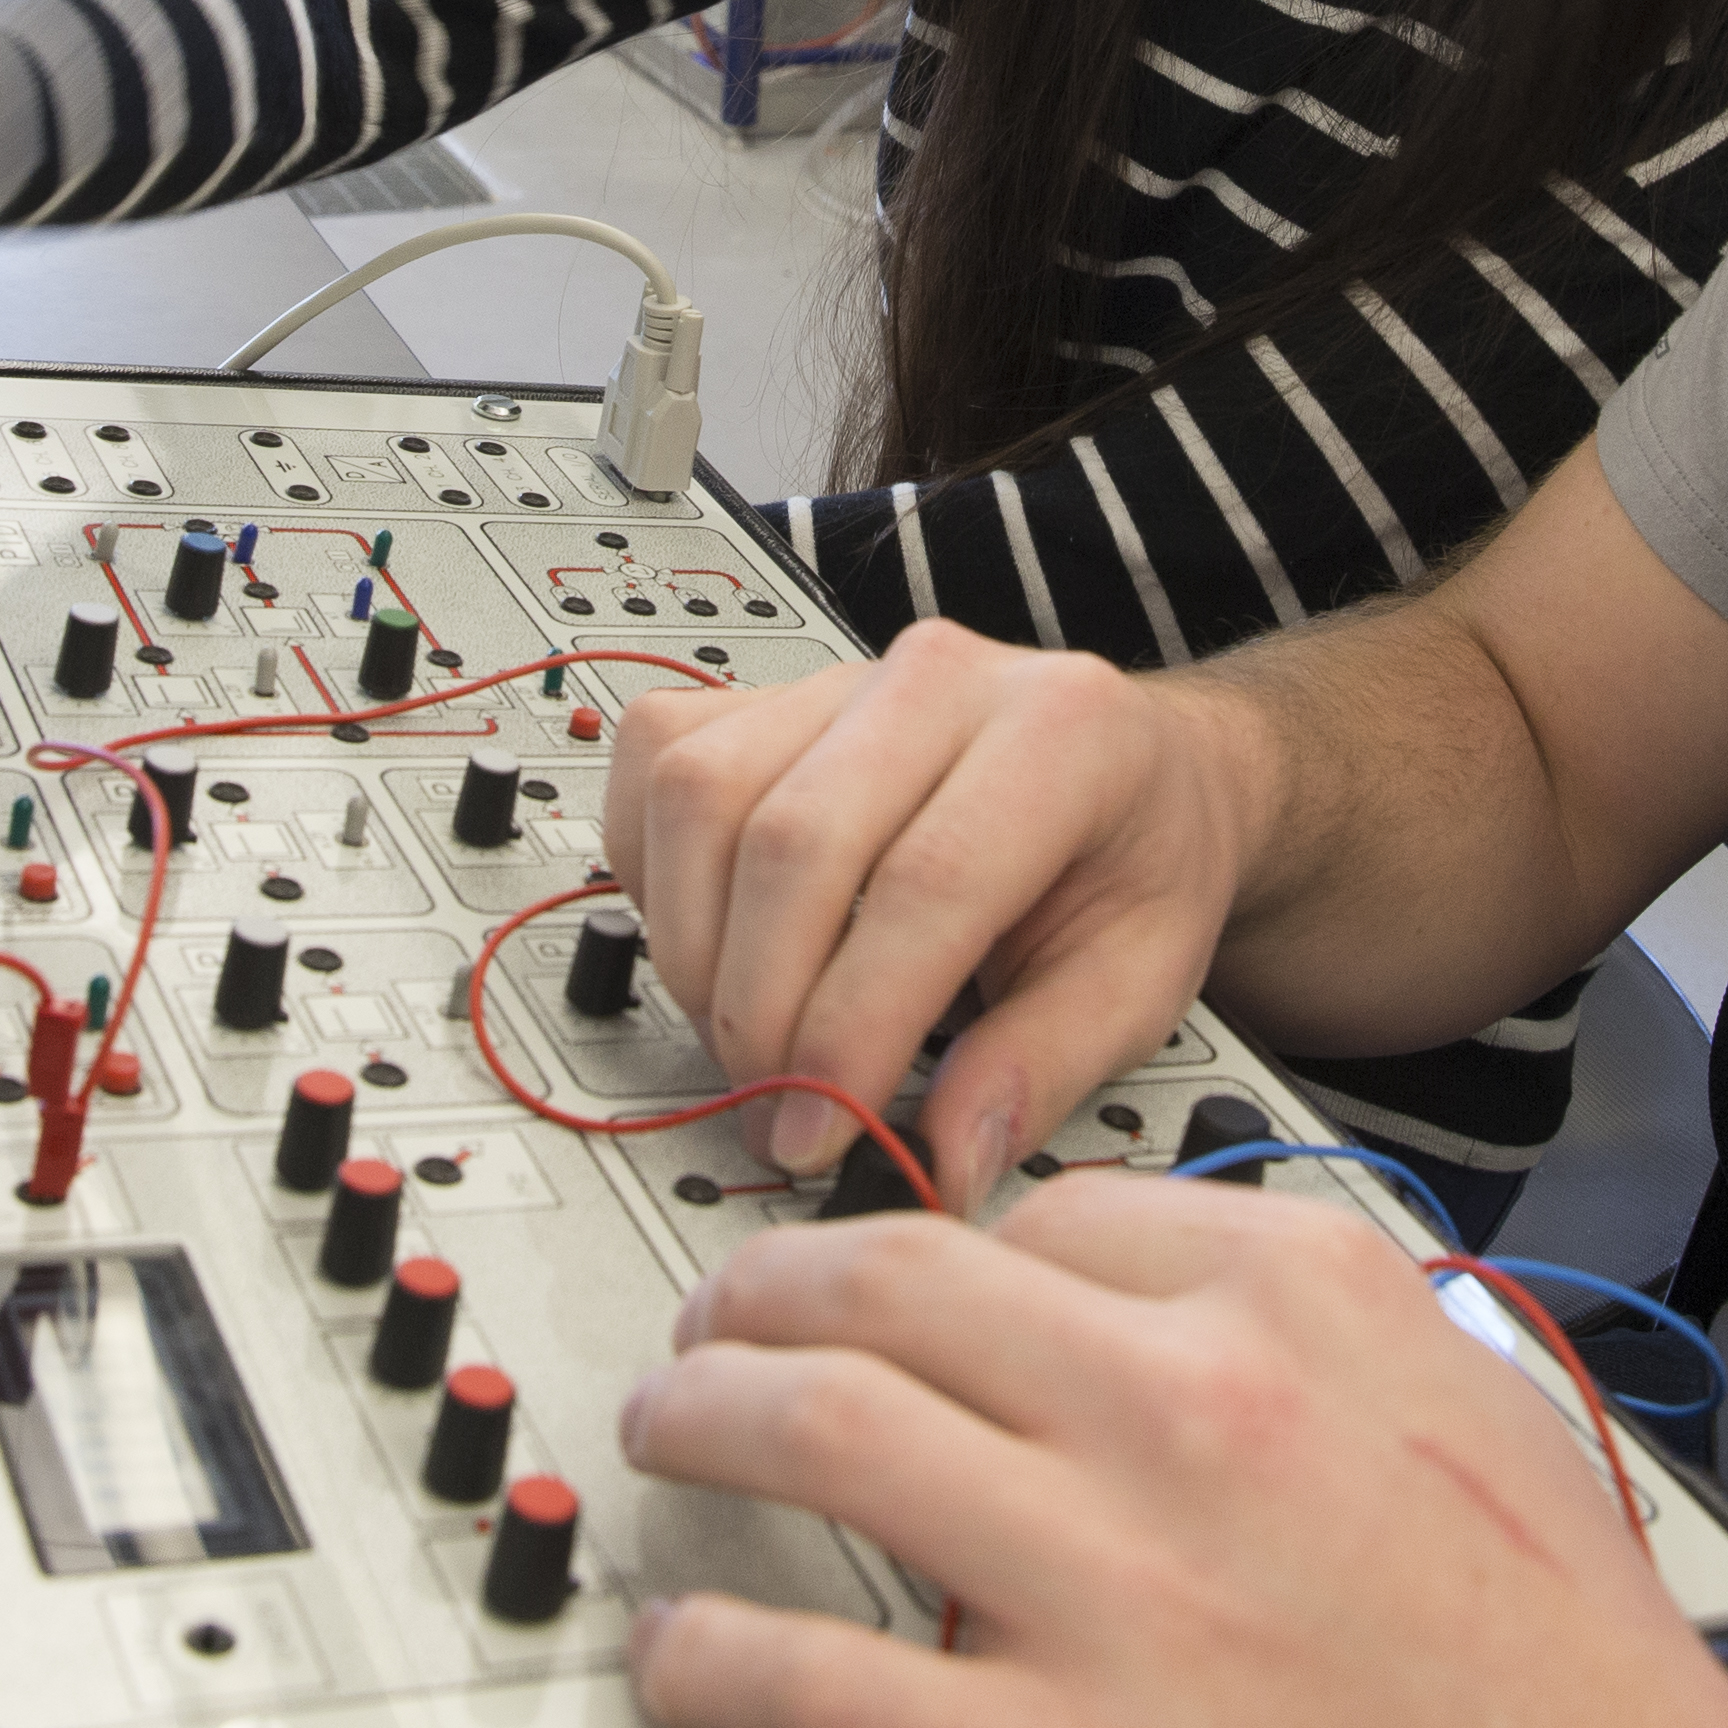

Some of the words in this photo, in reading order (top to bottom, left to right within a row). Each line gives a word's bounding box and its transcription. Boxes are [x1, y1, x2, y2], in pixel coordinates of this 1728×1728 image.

[413, 453, 432, 461] 2
[345, 471, 366, 480] D
[368, 460, 388, 469] A
[583, 472, 615, 502] SERIAL
